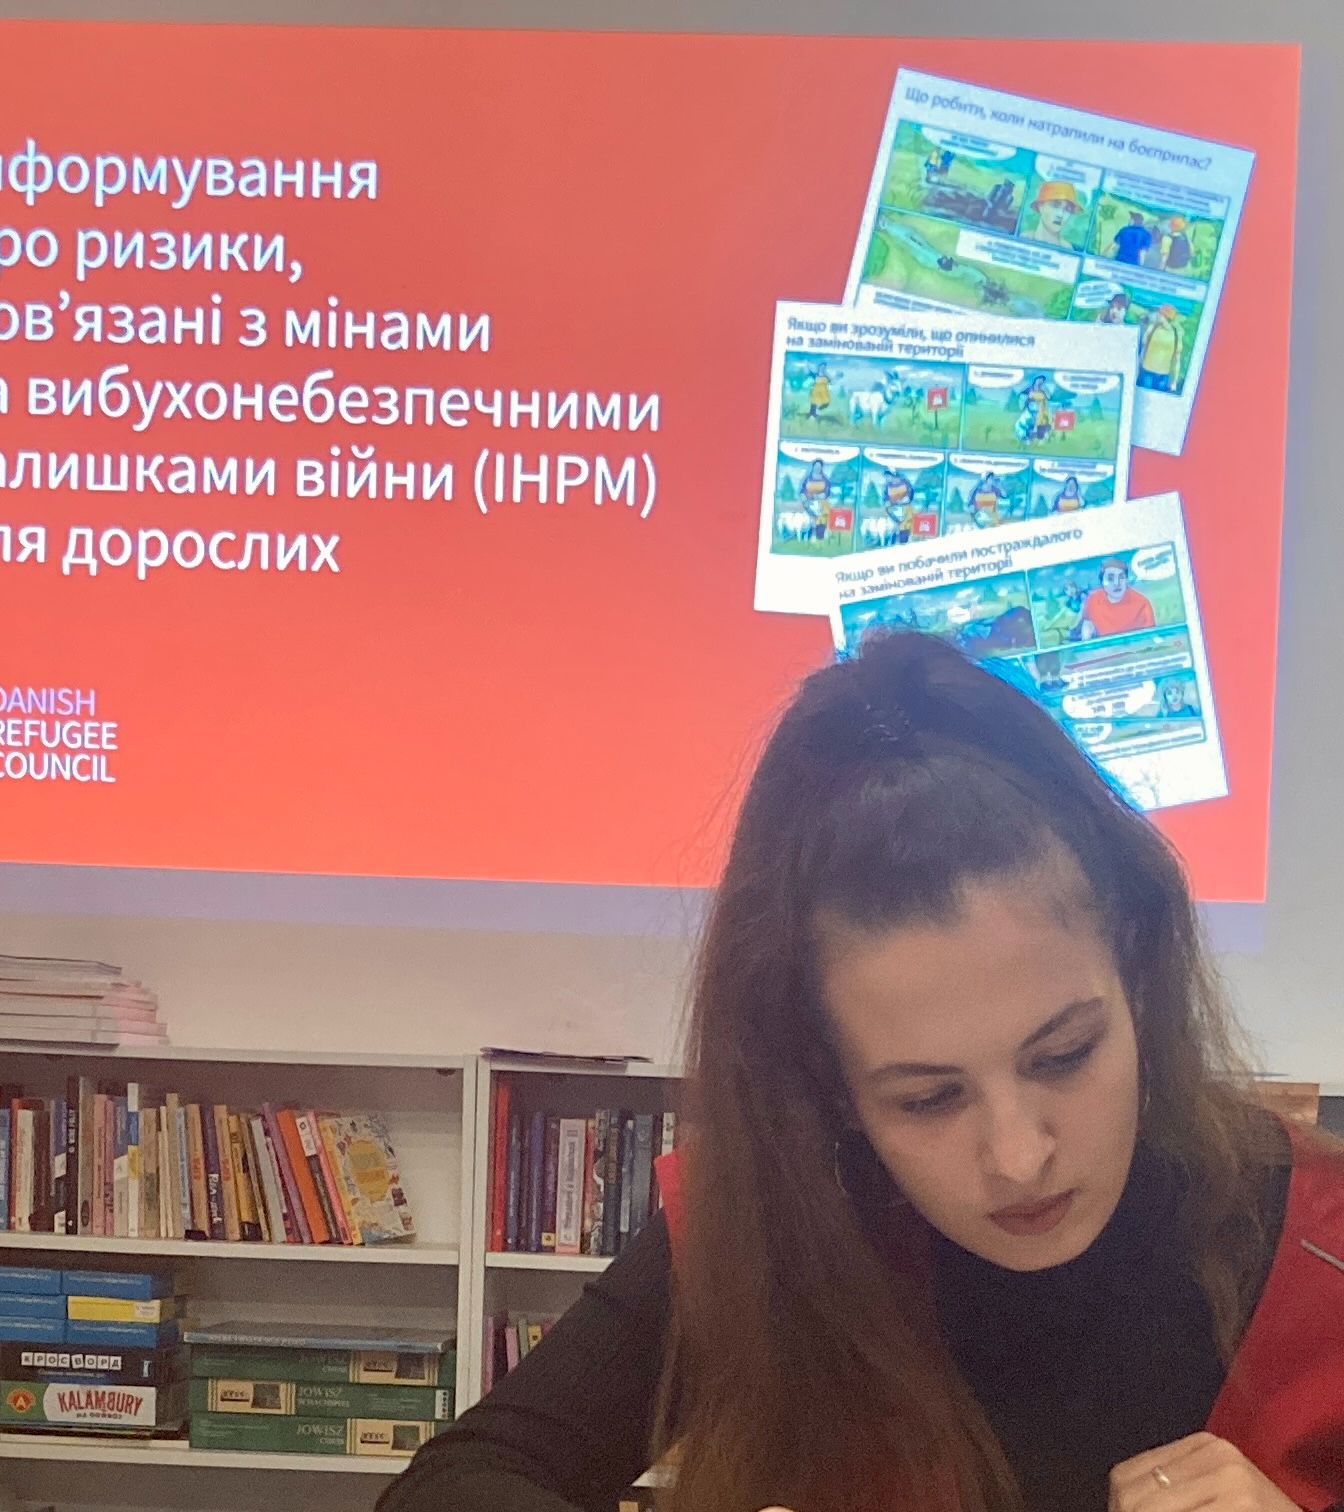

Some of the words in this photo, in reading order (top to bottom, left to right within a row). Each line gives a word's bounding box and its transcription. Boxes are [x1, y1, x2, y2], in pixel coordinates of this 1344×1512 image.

[1108, 137, 1125, 151] на
[76, 227, 304, 283] ризики,
[238, 306, 267, 346] з
[284, 296, 491, 352] мінами
[28, 365, 660, 431] вибухонебезпечними
[296, 445, 454, 502] війни
[473, 449, 658, 519] (ІНРМ)
[62, 524, 340, 580] дорослих
[22, 1353, 121, 1370] КРОСВОРД
[57, 1389, 143, 1416] KALAMBURY
